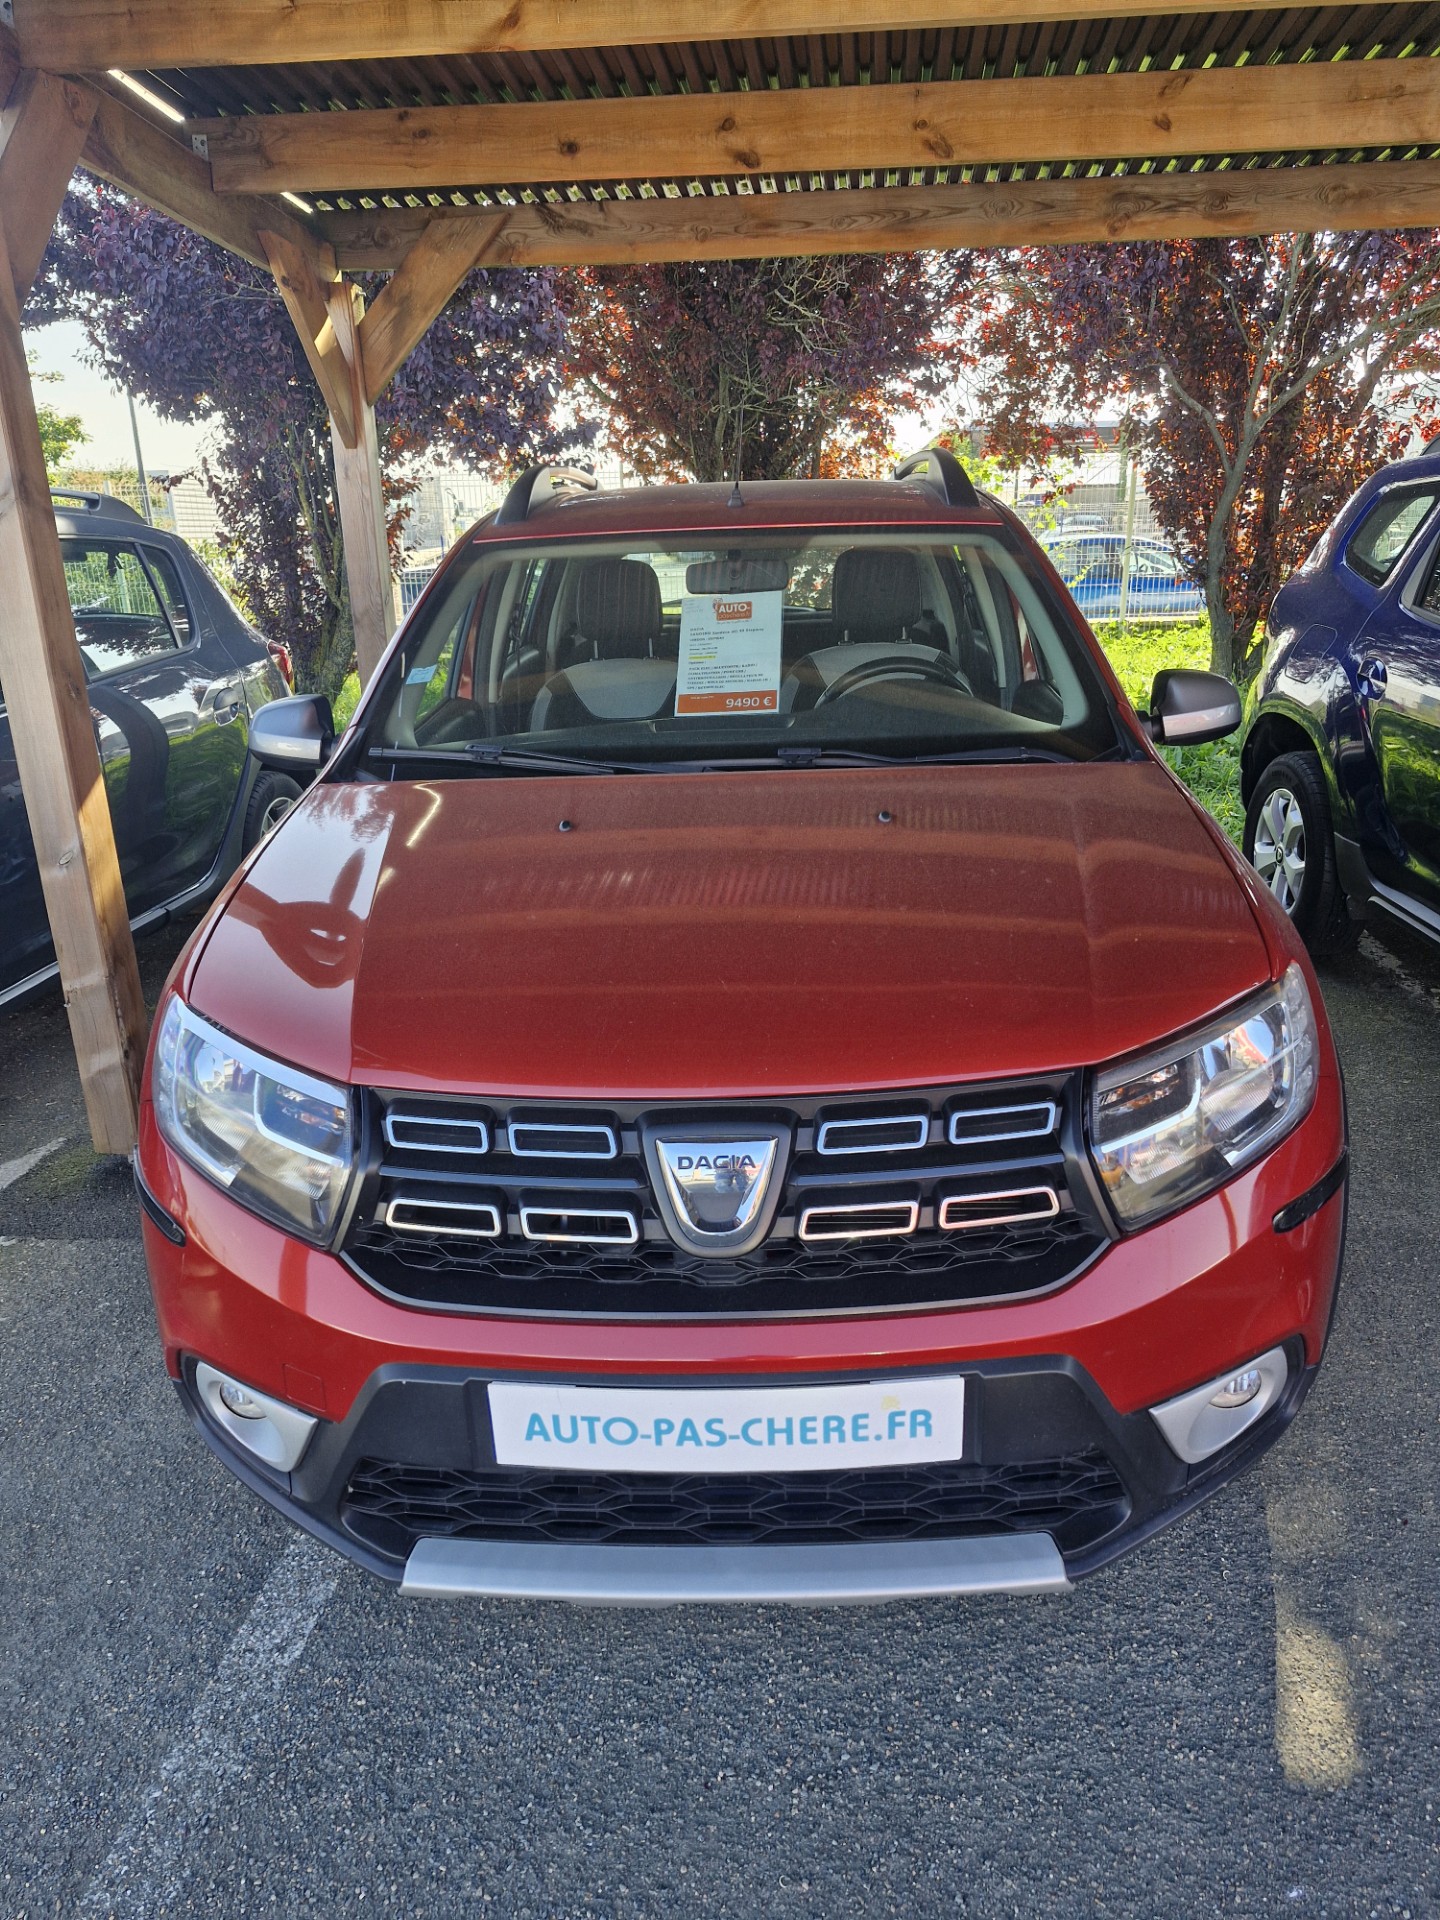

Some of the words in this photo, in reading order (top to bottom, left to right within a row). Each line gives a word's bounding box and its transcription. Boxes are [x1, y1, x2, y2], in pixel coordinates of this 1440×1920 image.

[726, 697, 760, 708] 9490
[763, 696, 772, 706] €
[677, 1155, 756, 1170] DACIA
[525, 1408, 933, 1447] AUTO-PAS-CHERE.FR
